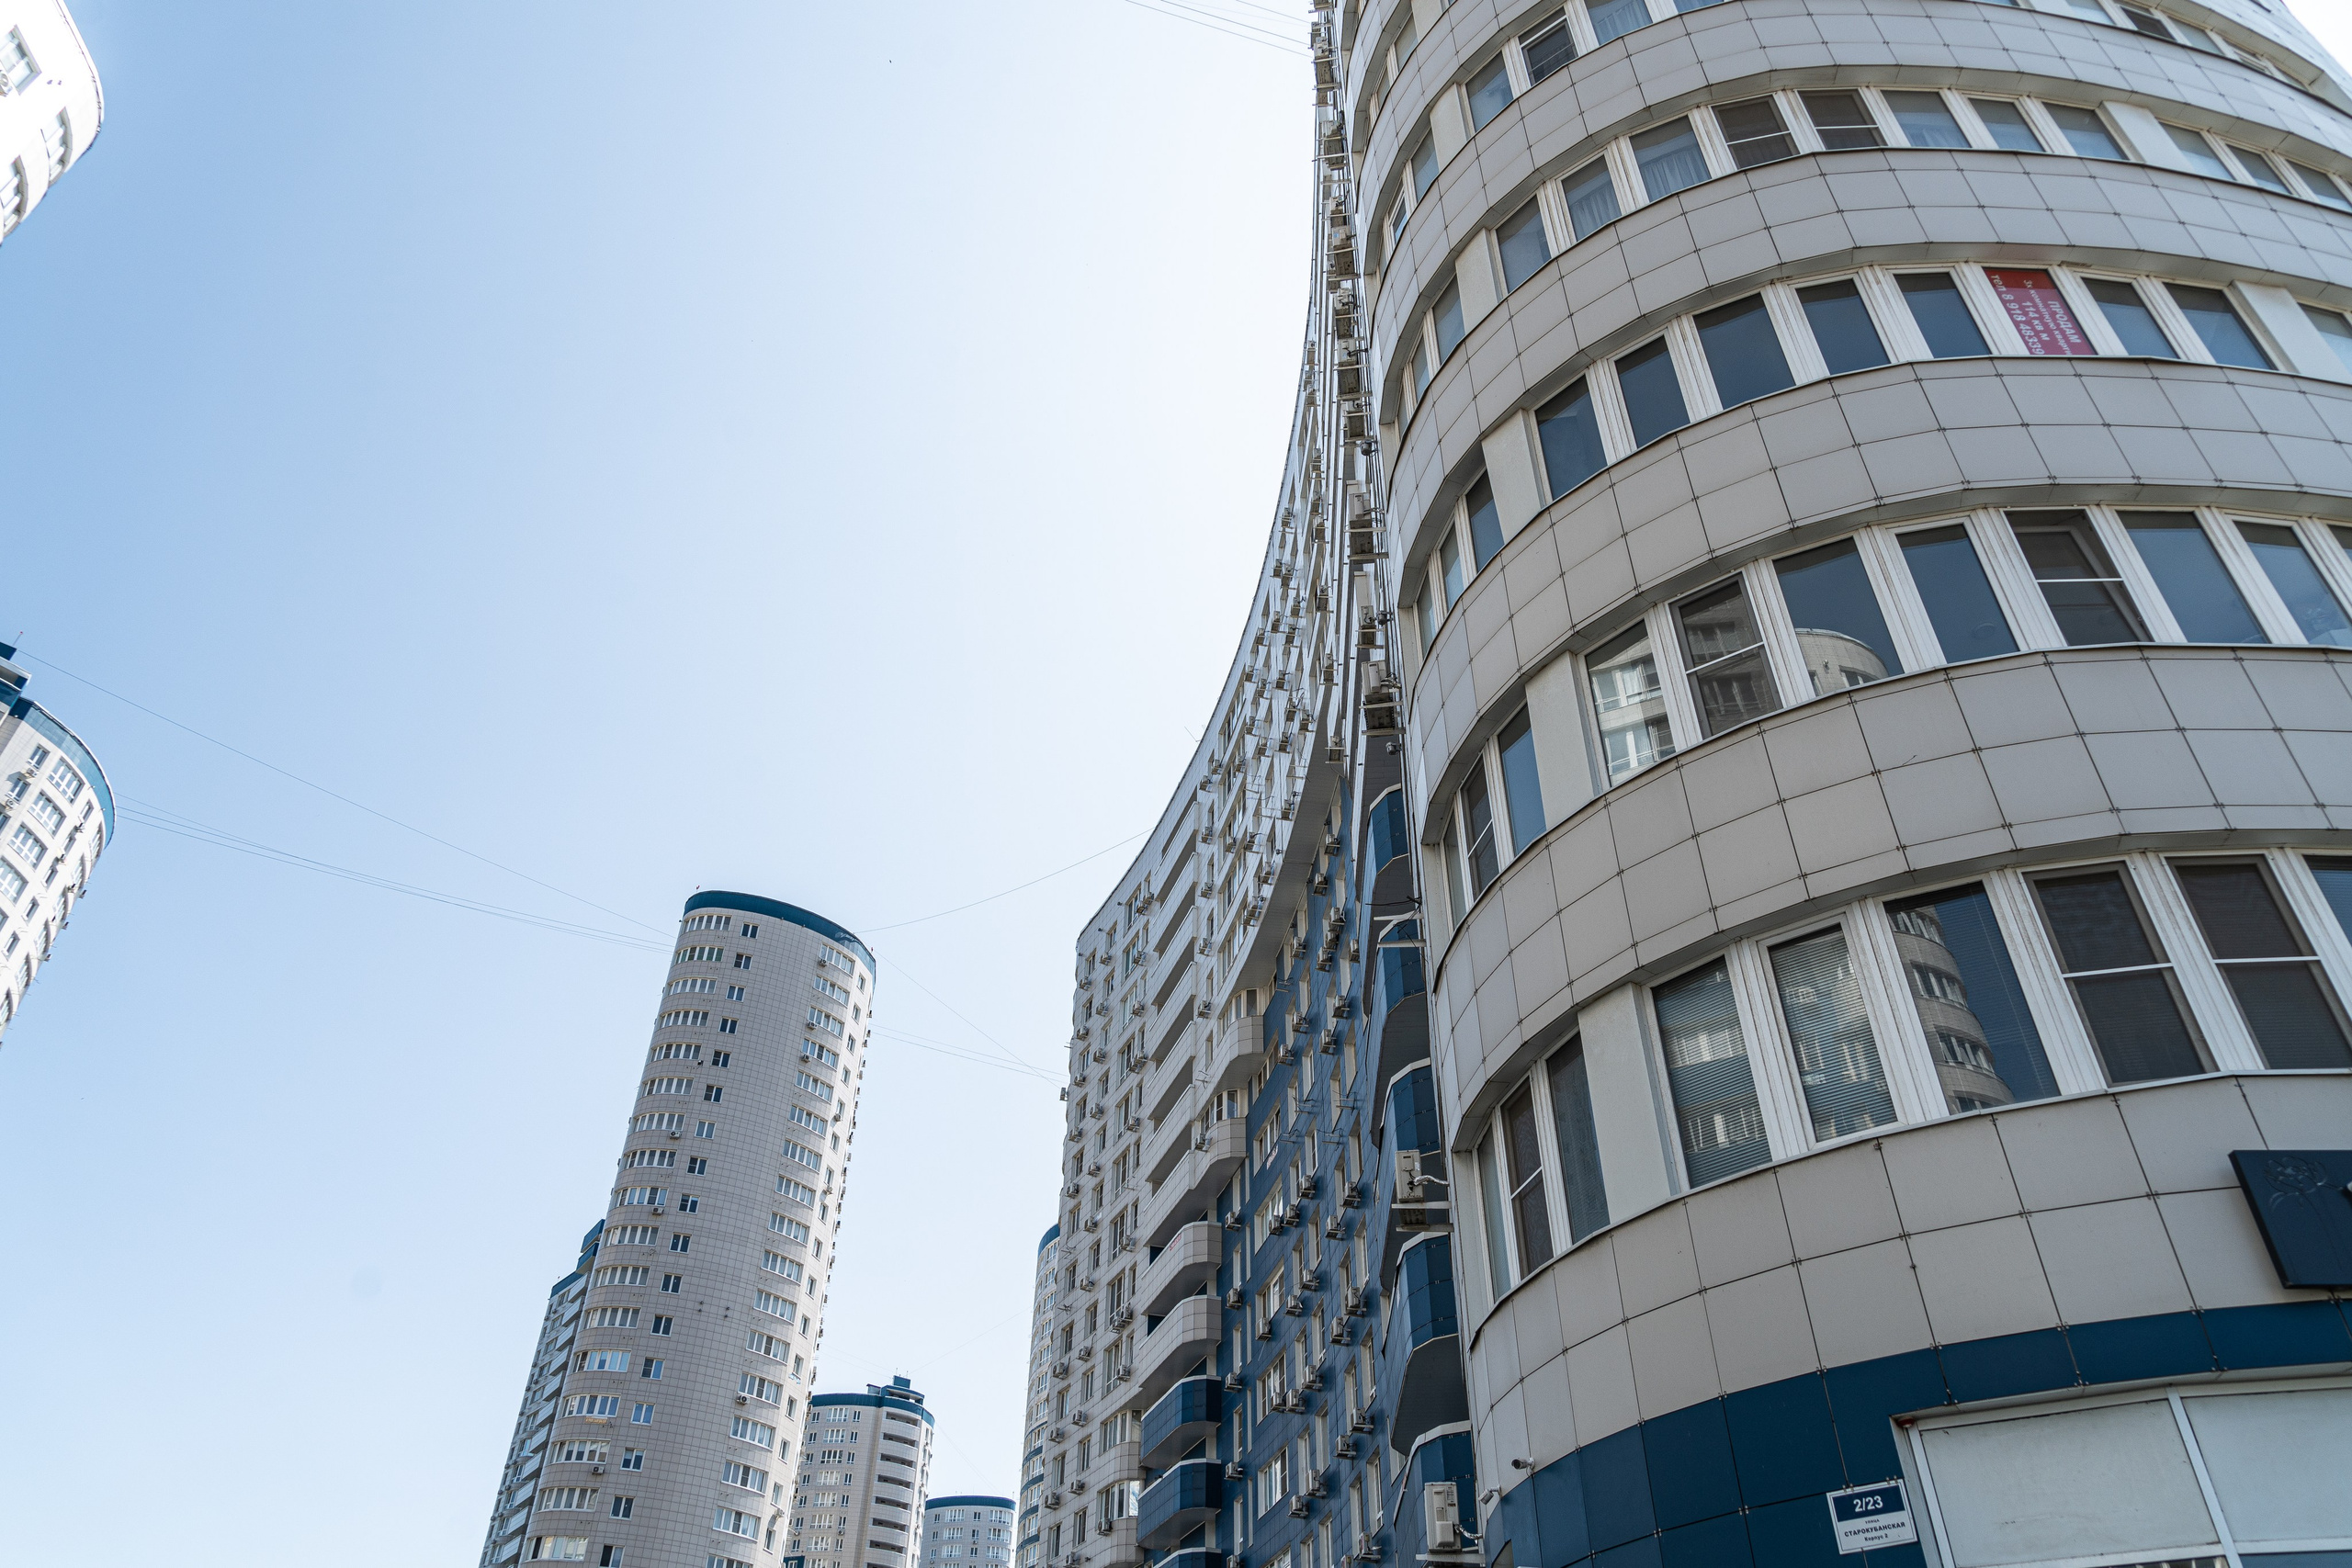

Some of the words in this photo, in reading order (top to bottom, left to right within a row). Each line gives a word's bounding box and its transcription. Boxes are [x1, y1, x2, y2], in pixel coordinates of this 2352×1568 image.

[1991, 275, 2007, 291] тел
[2007, 302, 2026, 321] 918
[2030, 289, 2056, 330] комнатную
[2022, 301, 2039, 318] 114
[2032, 320, 2044, 331] кв
[2048, 300, 2082, 344] ПРОДАМ
[1853, 1495, 1883, 1512] 2/23
[1844, 1521, 1905, 1537] СТАРОКУБАНСКАЯ
